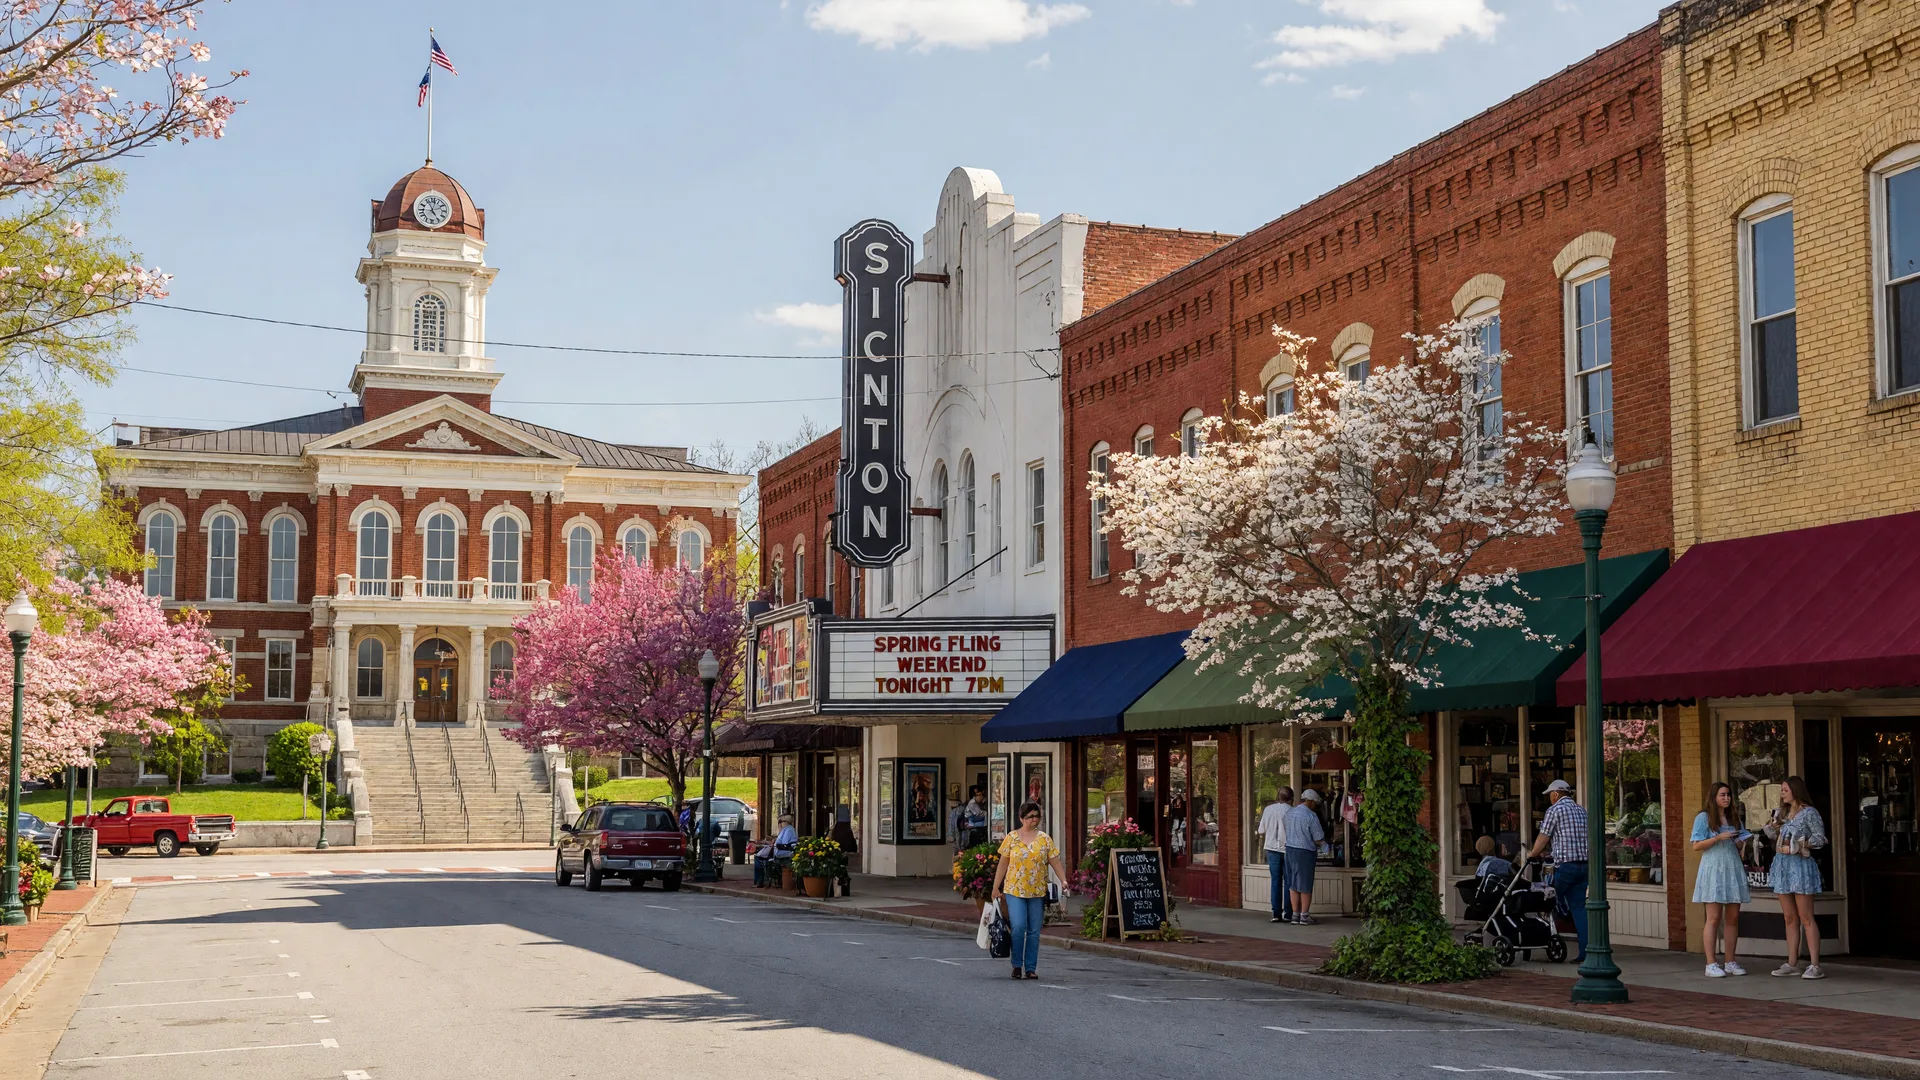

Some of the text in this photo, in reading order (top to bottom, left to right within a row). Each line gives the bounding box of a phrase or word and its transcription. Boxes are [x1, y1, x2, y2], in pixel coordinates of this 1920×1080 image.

[861, 242, 889, 538] SICNTON
[874, 635, 1001, 652] SPRING FLING
[897, 656, 986, 672] WEEKEND
[875, 676, 1004, 693] TONIGHT 7PM
